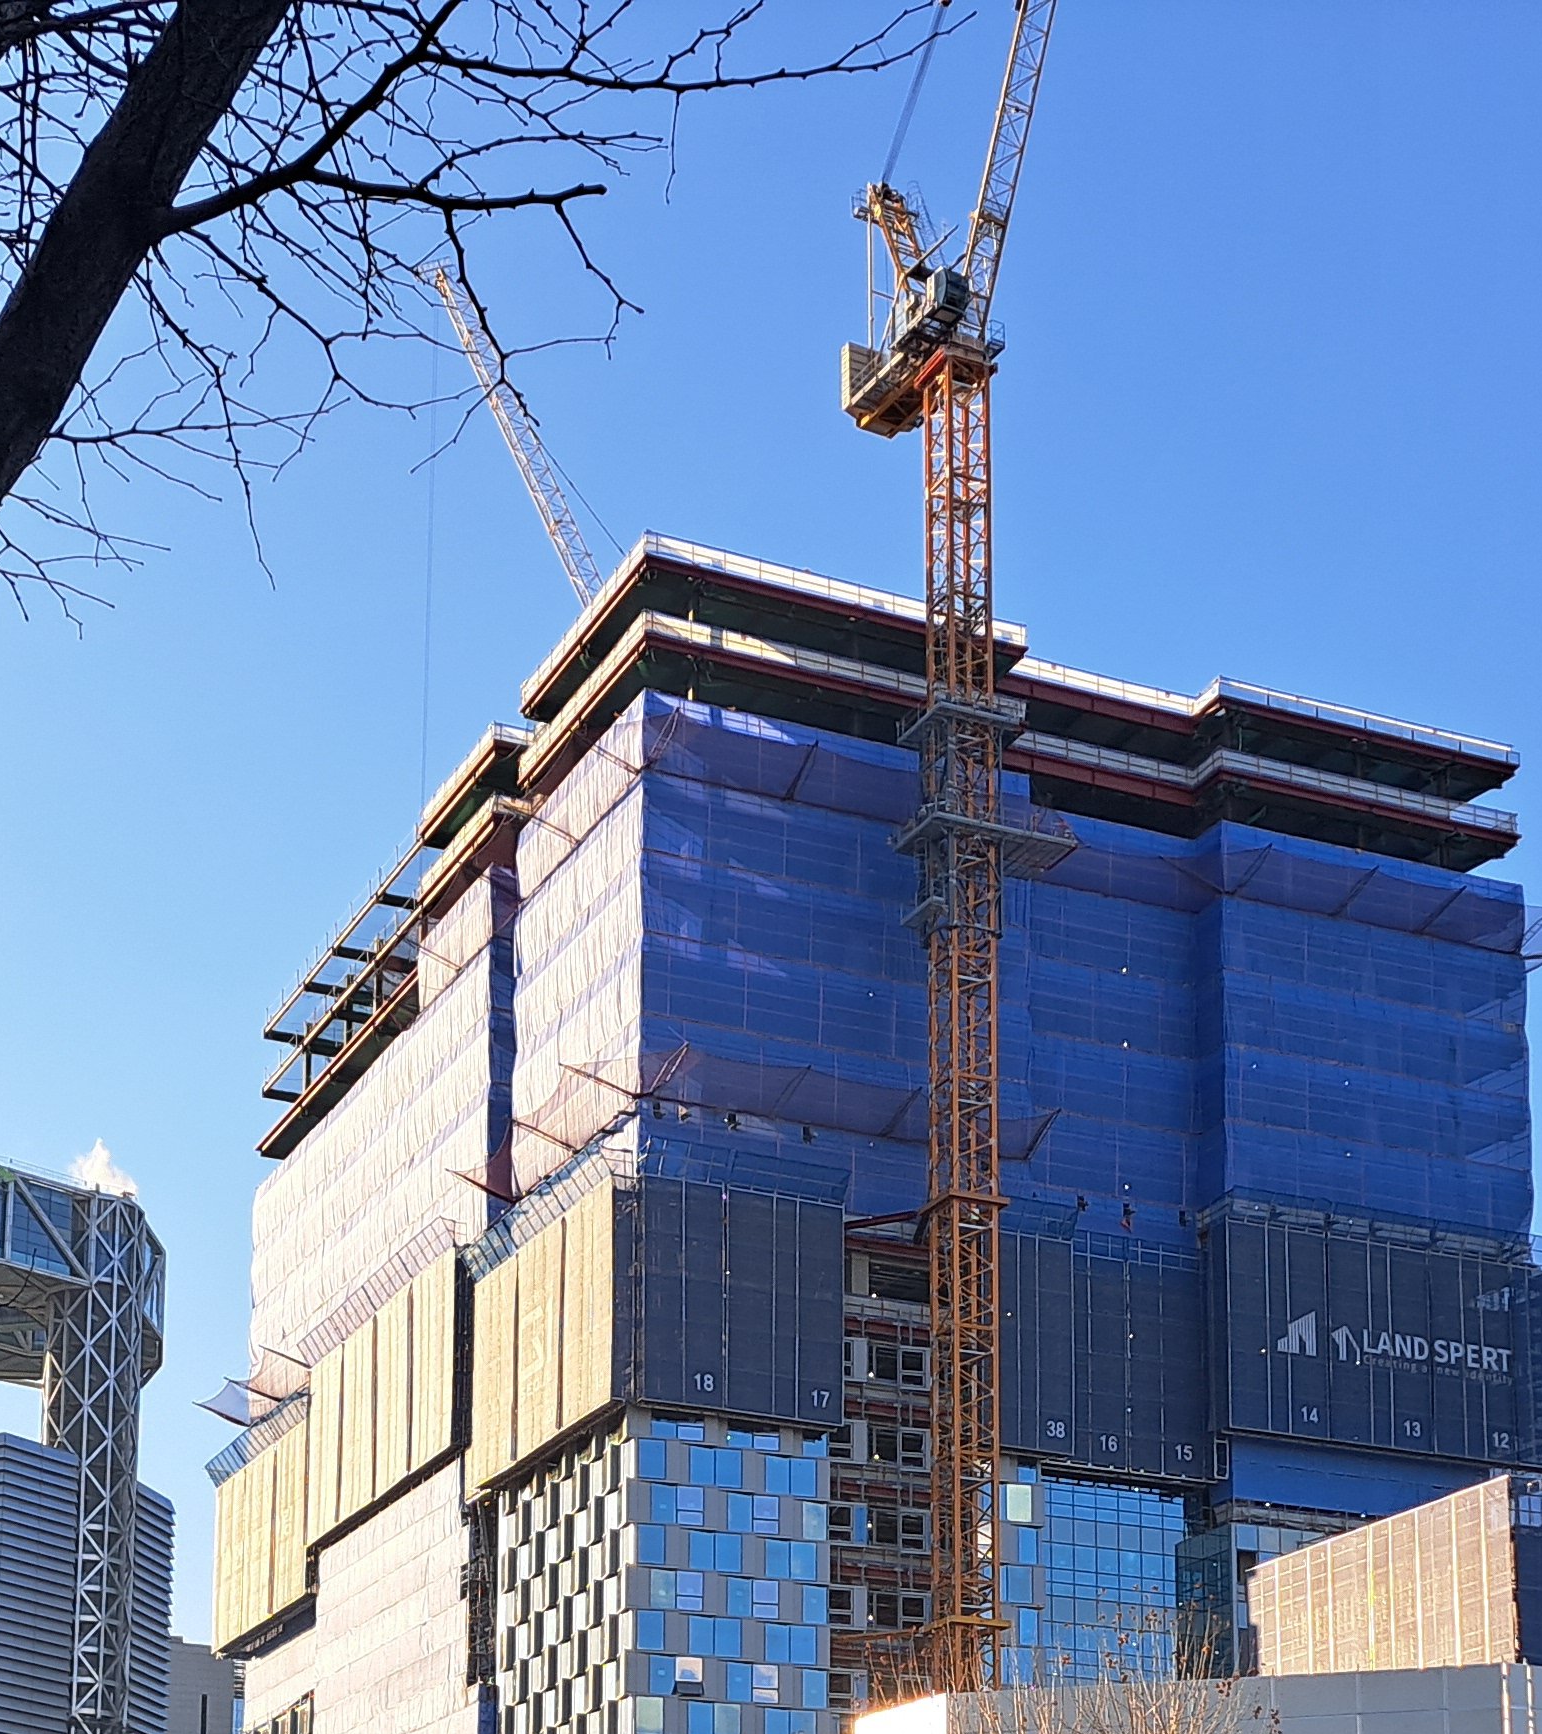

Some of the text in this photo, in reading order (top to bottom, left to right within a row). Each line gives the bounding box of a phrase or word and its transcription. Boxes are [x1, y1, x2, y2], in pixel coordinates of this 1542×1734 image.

[1363, 1328, 1512, 1373] LAND SPERT
[694, 1373, 714, 1392] 18
[811, 1389, 830, 1409] 17
[1301, 1406, 1319, 1424] 14
[1046, 1420, 1066, 1438] 38
[1404, 1420, 1421, 1437] 13
[1099, 1435, 1118, 1452] 16
[1493, 1432, 1509, 1449] 12
[1175, 1444, 1193, 1461] 15
